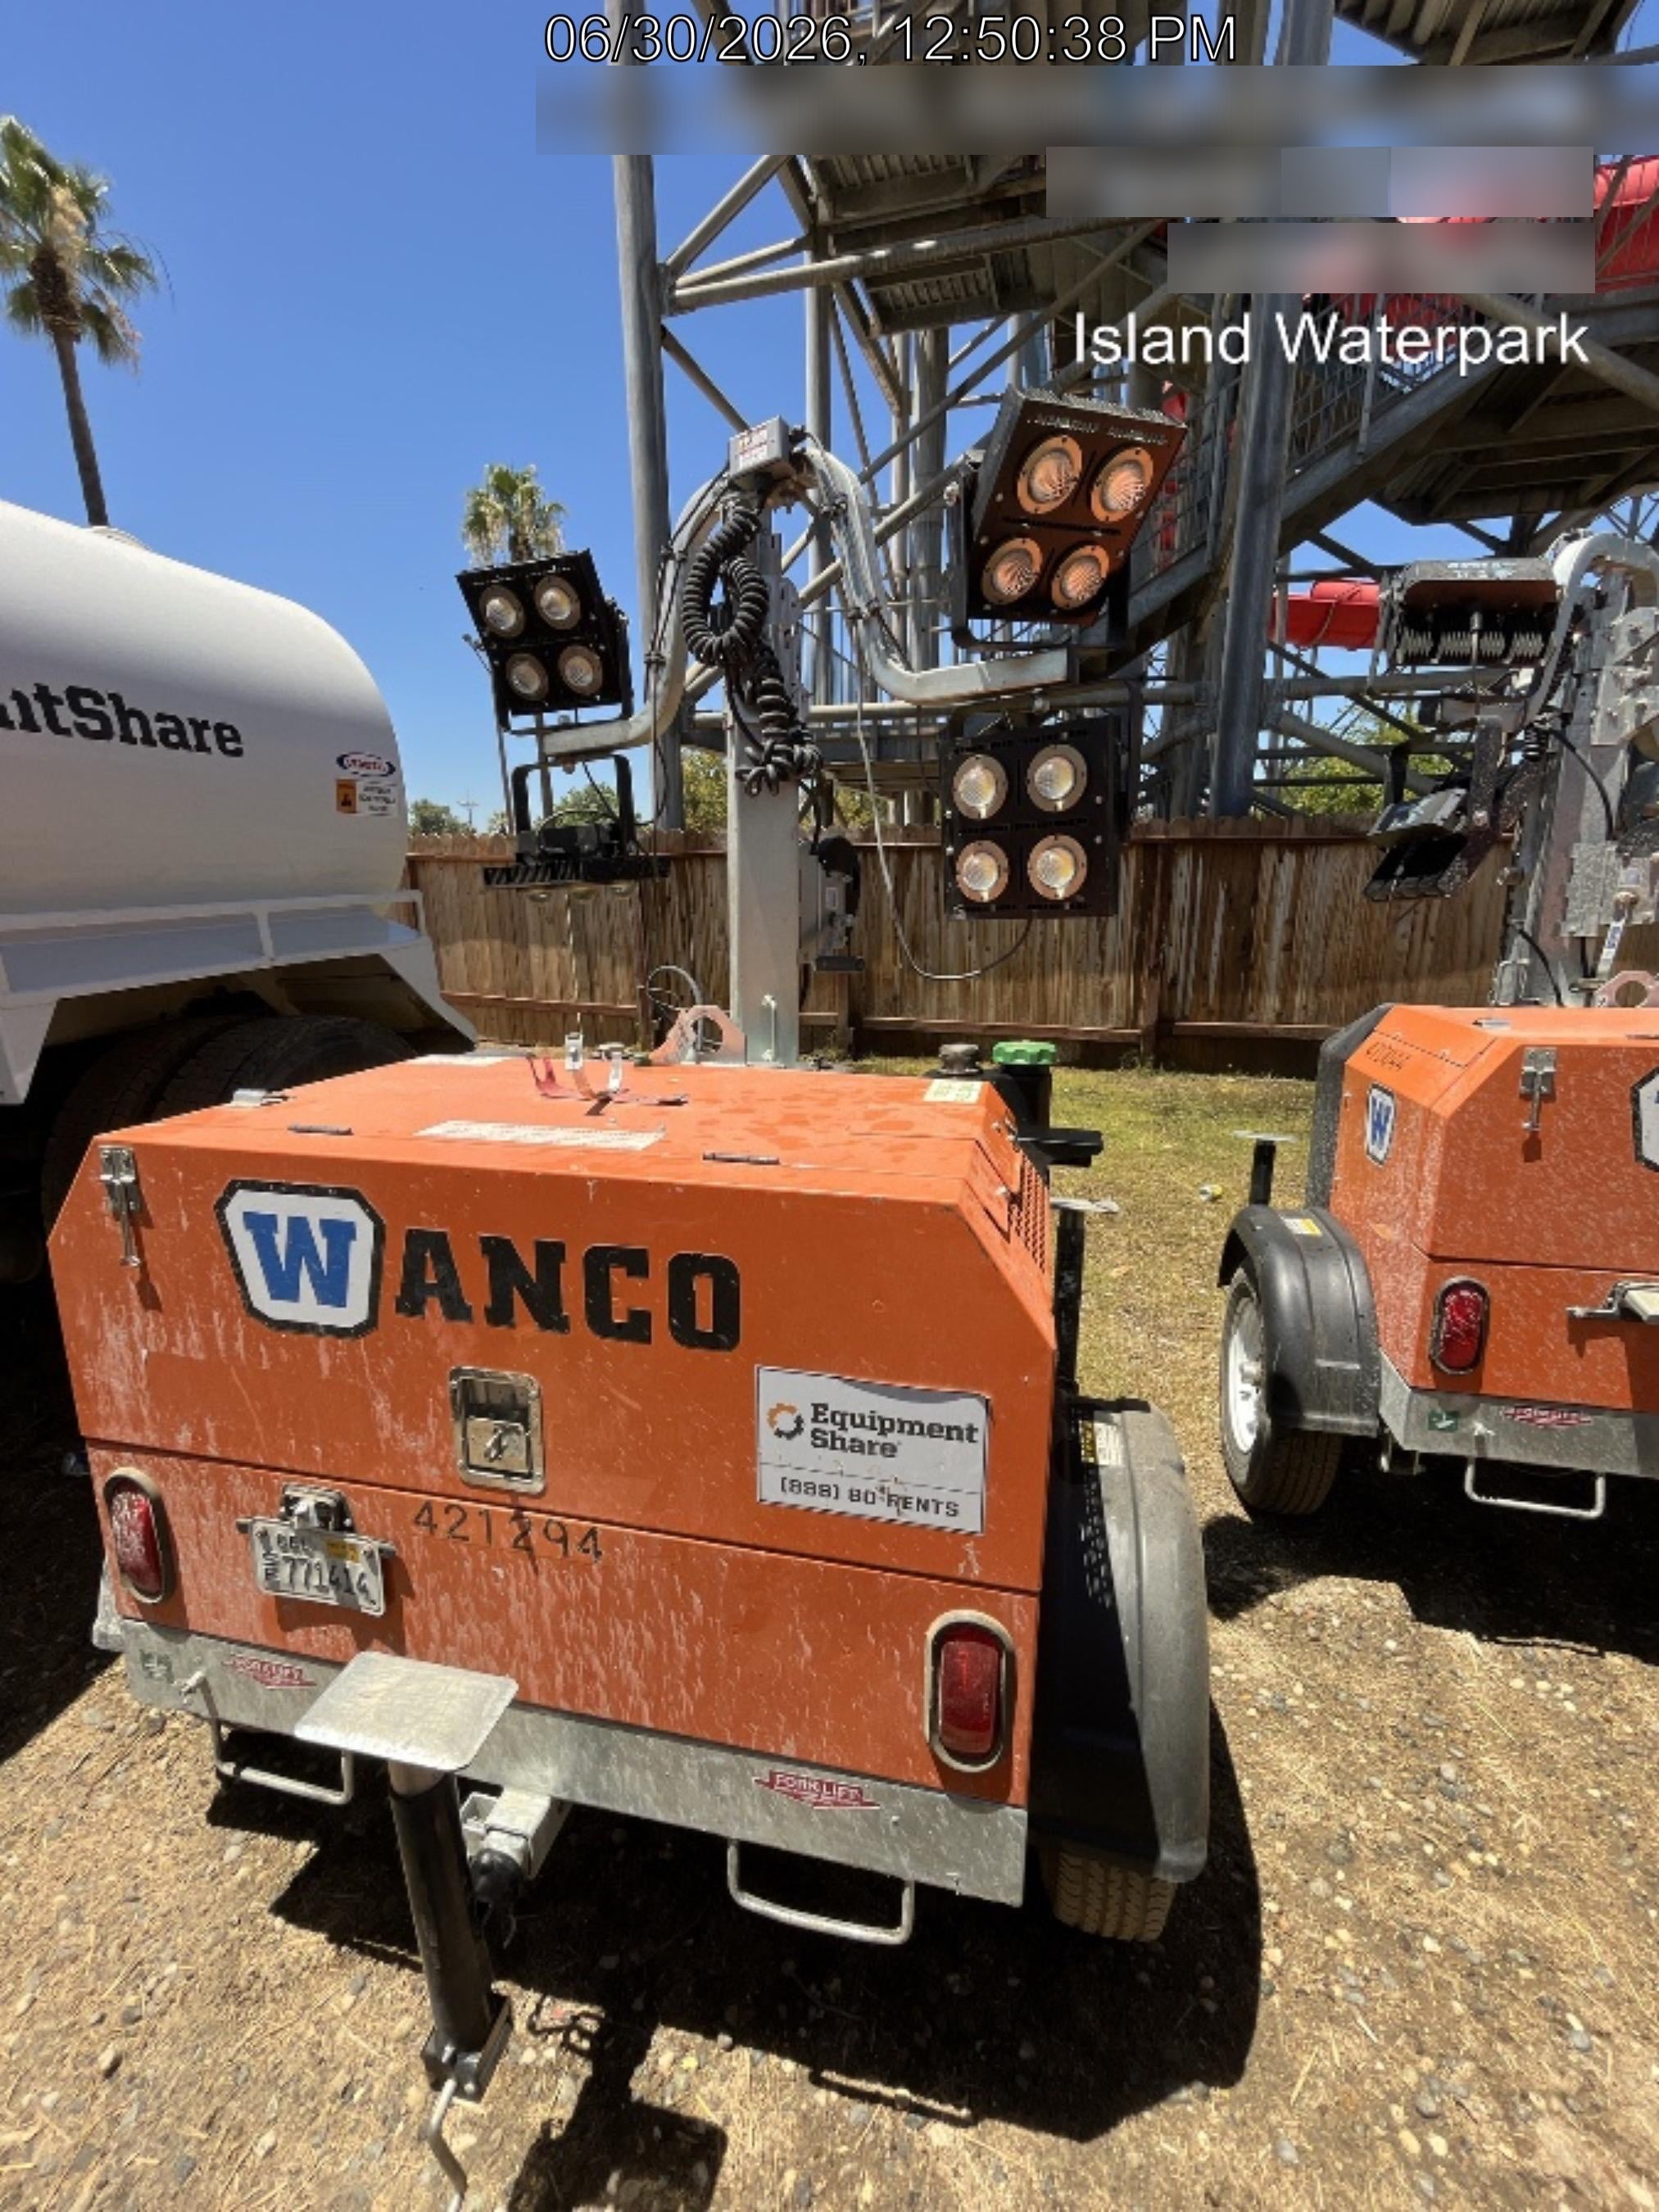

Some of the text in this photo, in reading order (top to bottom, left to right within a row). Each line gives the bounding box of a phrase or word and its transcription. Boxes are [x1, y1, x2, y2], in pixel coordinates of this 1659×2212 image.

[243, 1211, 741, 1352] WANCO
[810, 1402, 979, 1444] Equipment
[810, 1427, 899, 1458] Share
[413, 1500, 604, 1563] 421294
